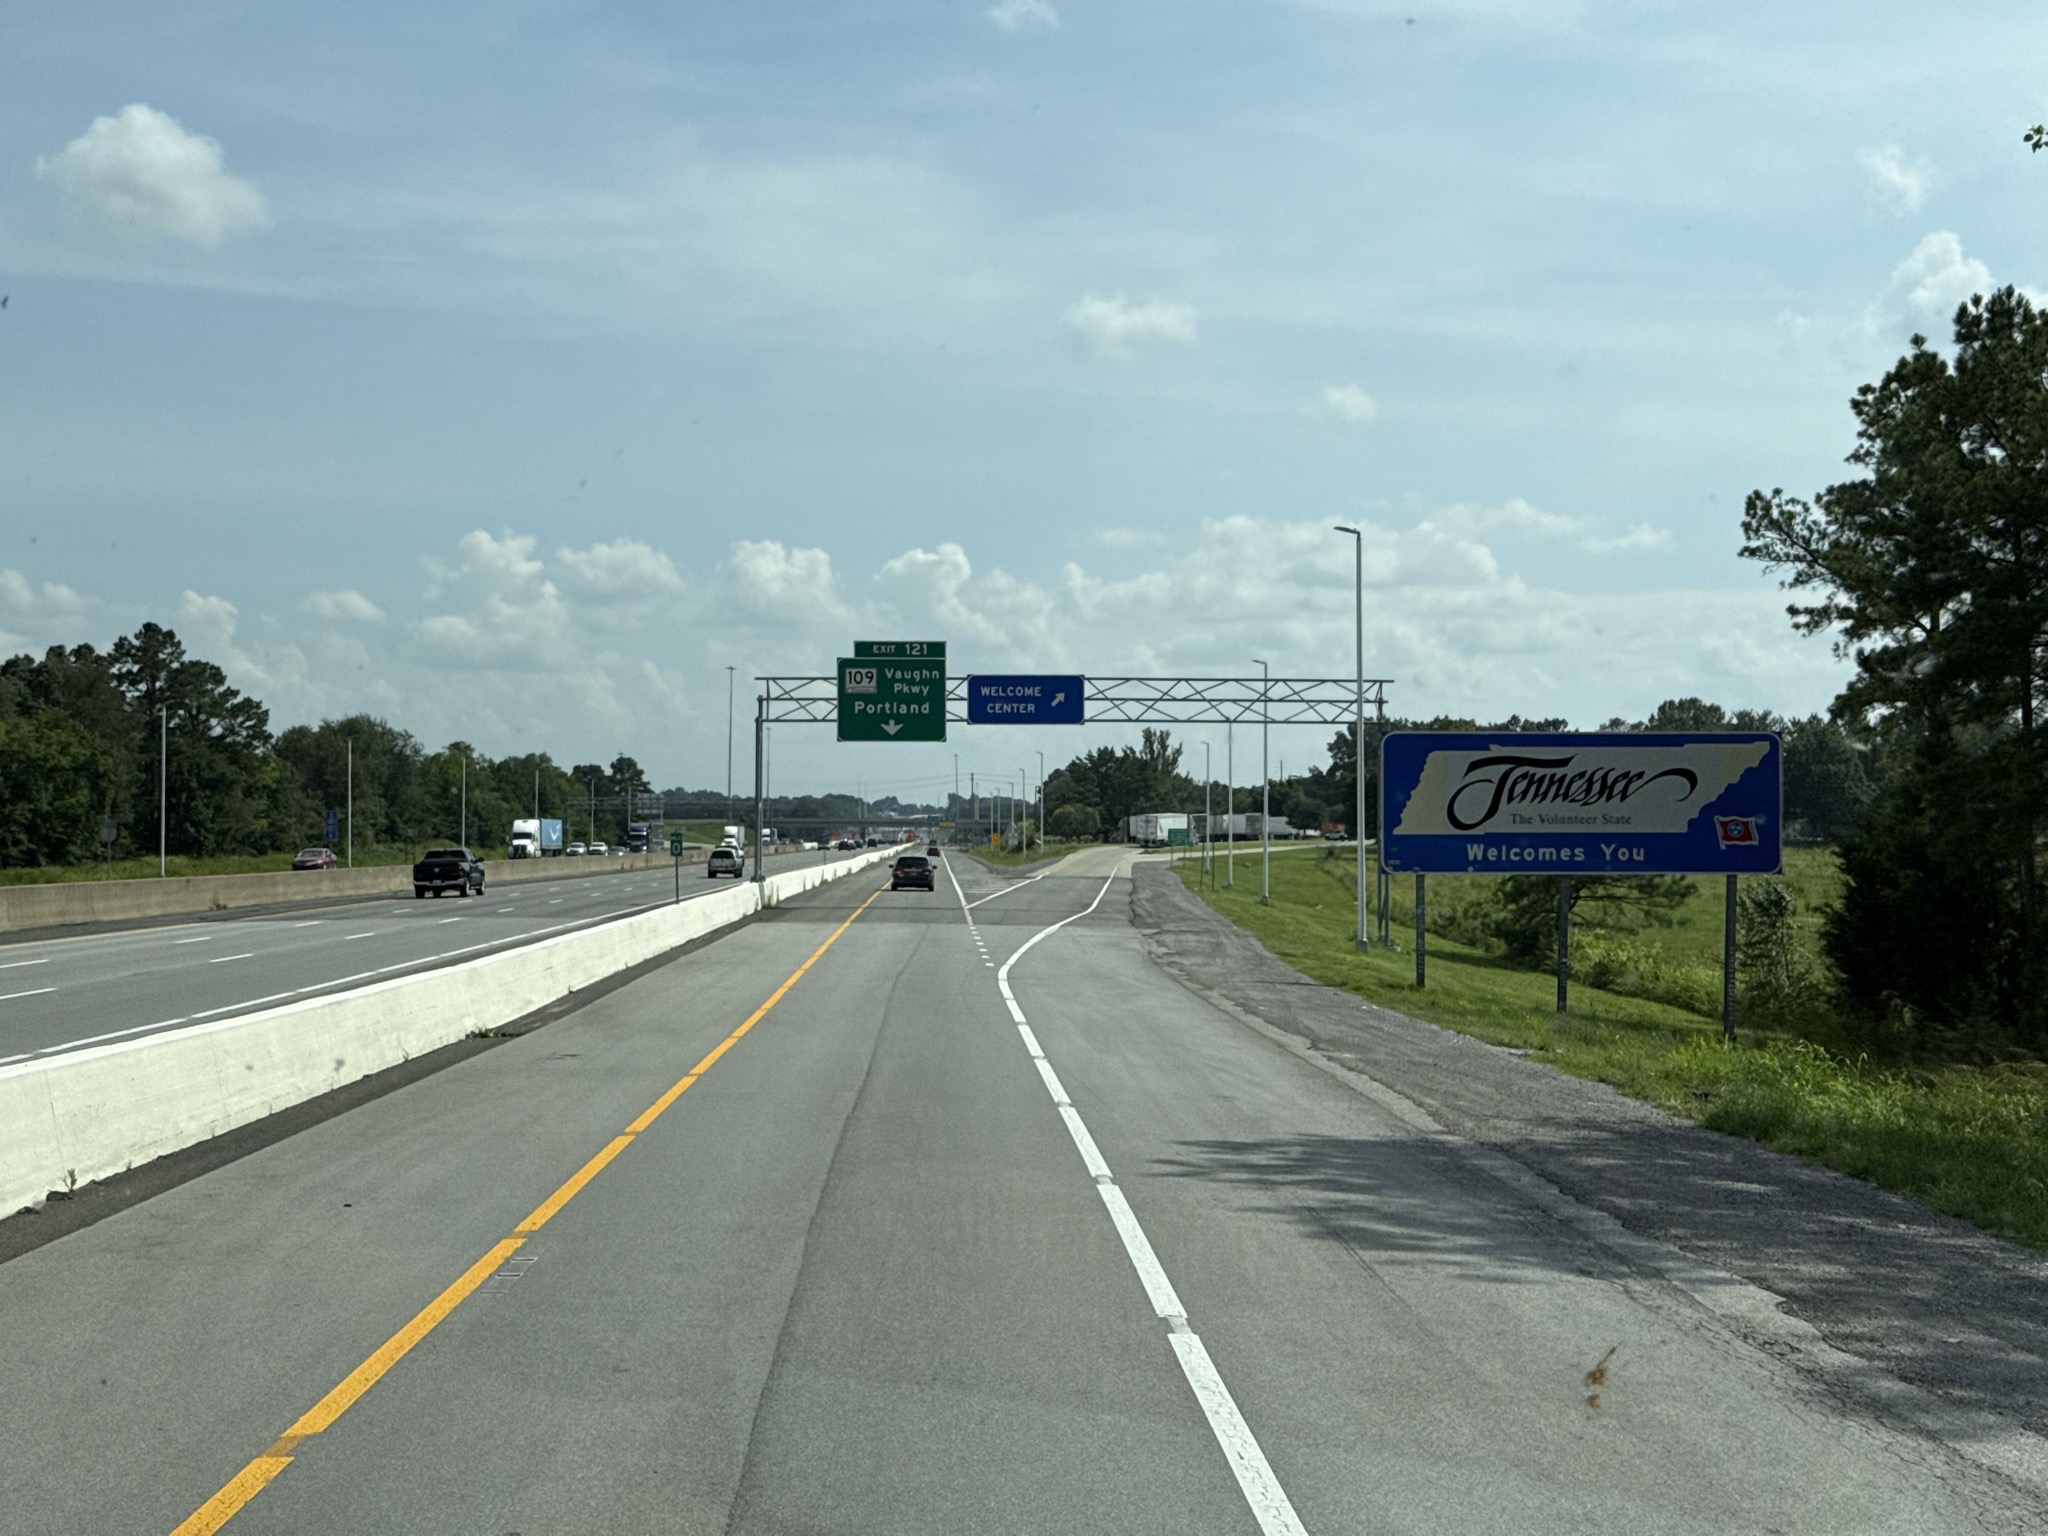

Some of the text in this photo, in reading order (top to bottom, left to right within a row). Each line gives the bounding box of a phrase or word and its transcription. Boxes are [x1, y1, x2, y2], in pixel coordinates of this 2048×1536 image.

[873, 643, 928, 655] EXIT 121
[847, 670, 874, 685] 109
[885, 668, 940, 681] Vaughn
[893, 682, 930, 696] Pkwy
[980, 686, 1042, 697] WELCOME
[854, 701, 930, 714] Portland
[986, 703, 1036, 714] CENTER
[1446, 753, 1698, 831] Tennessee
[1510, 813, 1632, 825] The Volunteer State
[1466, 843, 1646, 861] Welcomes You
